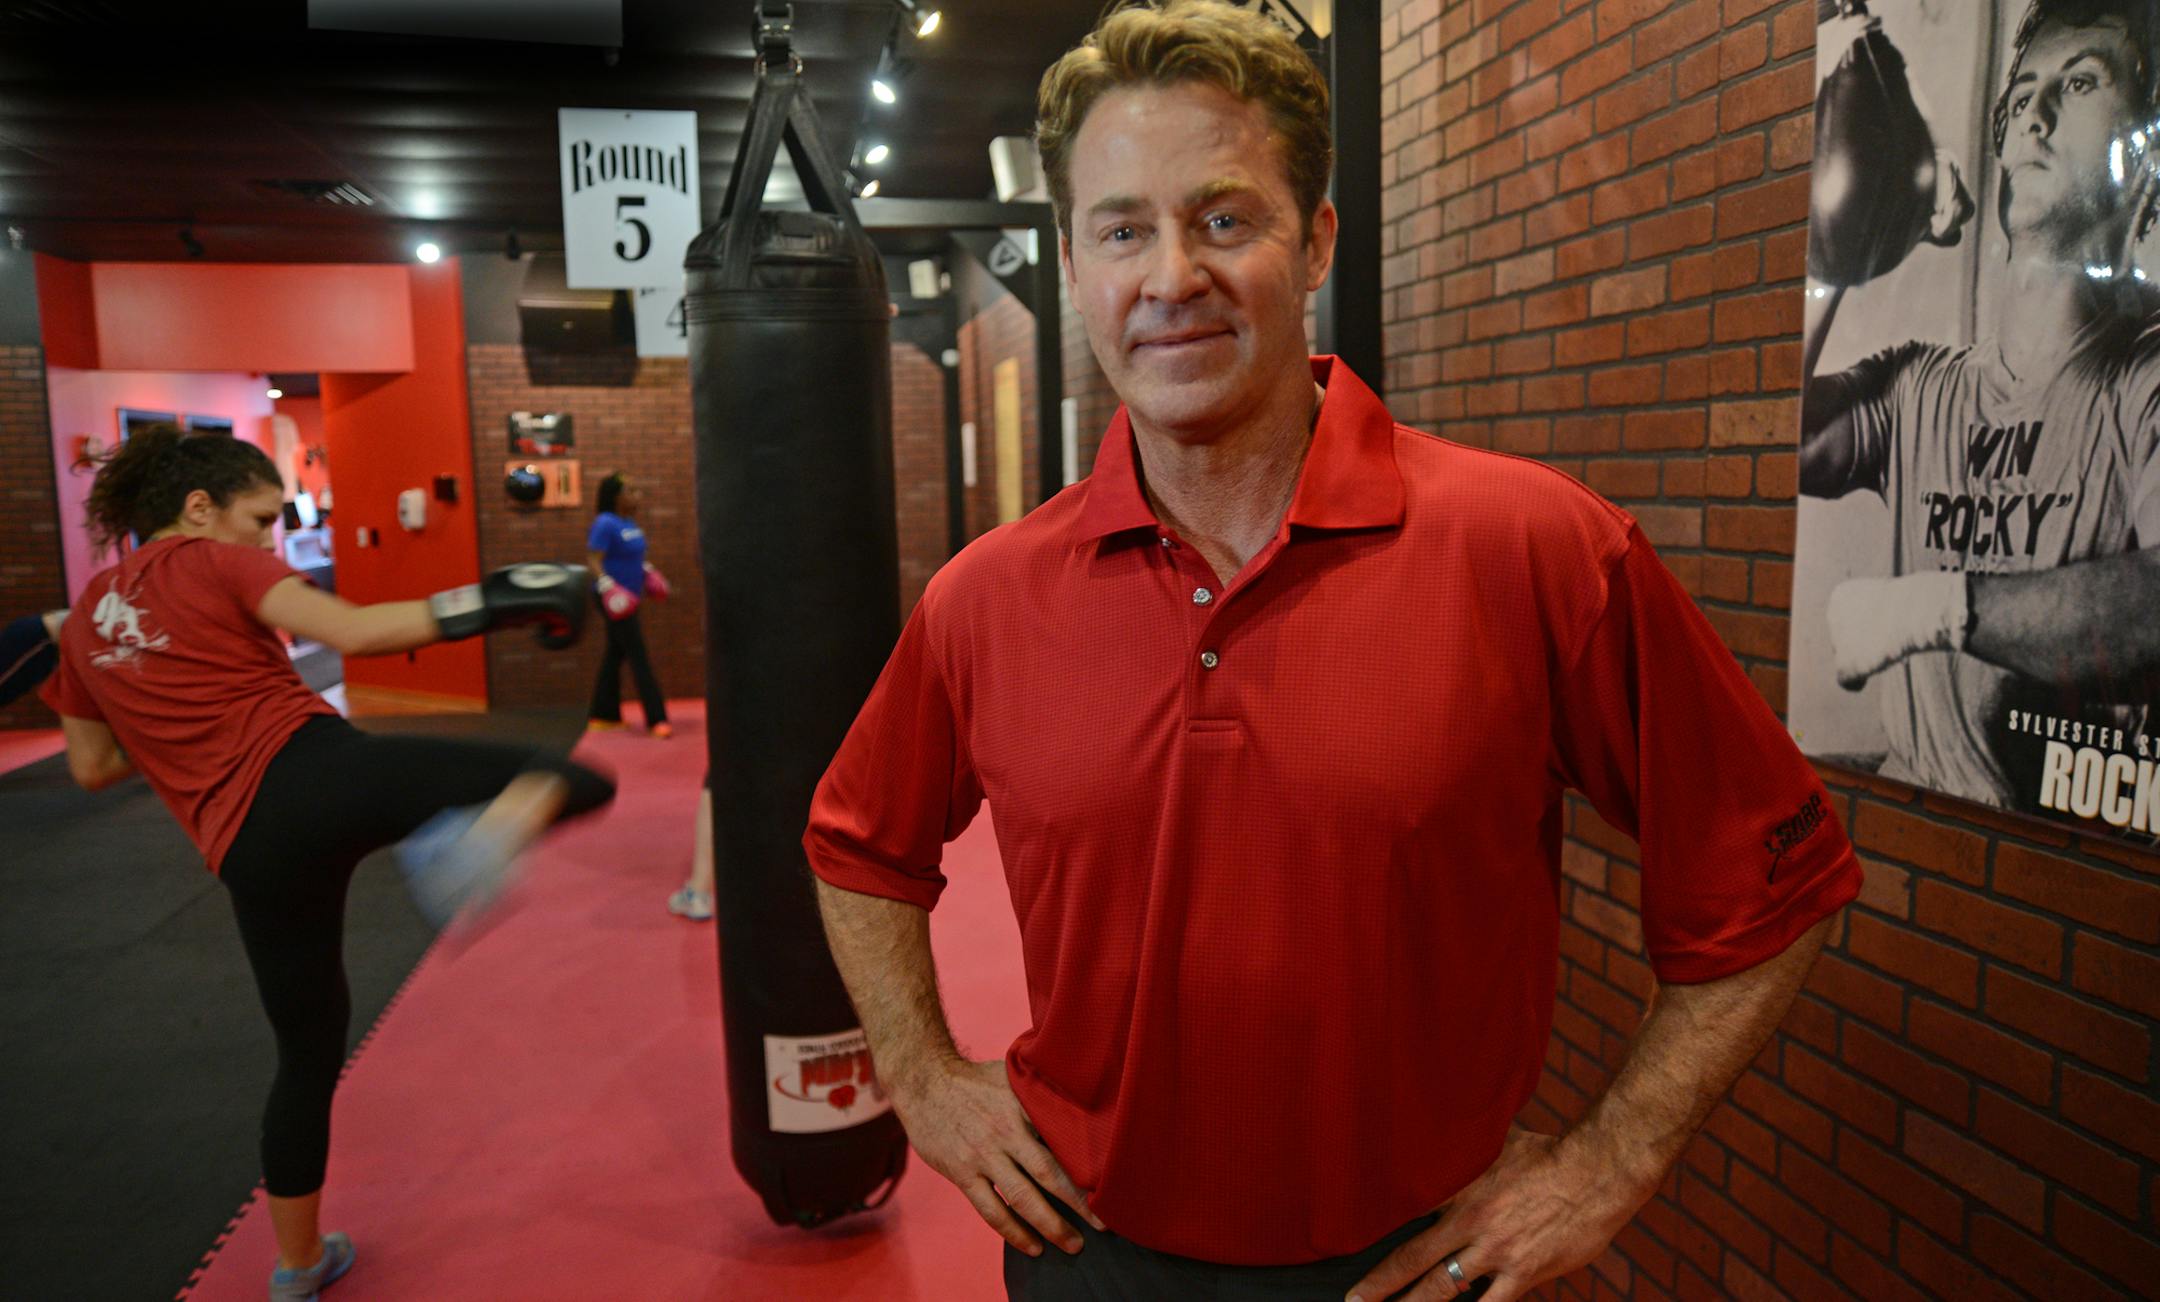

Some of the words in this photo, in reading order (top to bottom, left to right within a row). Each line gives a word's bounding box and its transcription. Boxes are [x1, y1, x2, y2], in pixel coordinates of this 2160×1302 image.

[570, 140, 688, 195] Round
[615, 196, 652, 262] 5
[664, 296, 687, 338] 4
[1967, 421, 2044, 480] WIN
[2008, 709, 2124, 751] SYLVESTER
